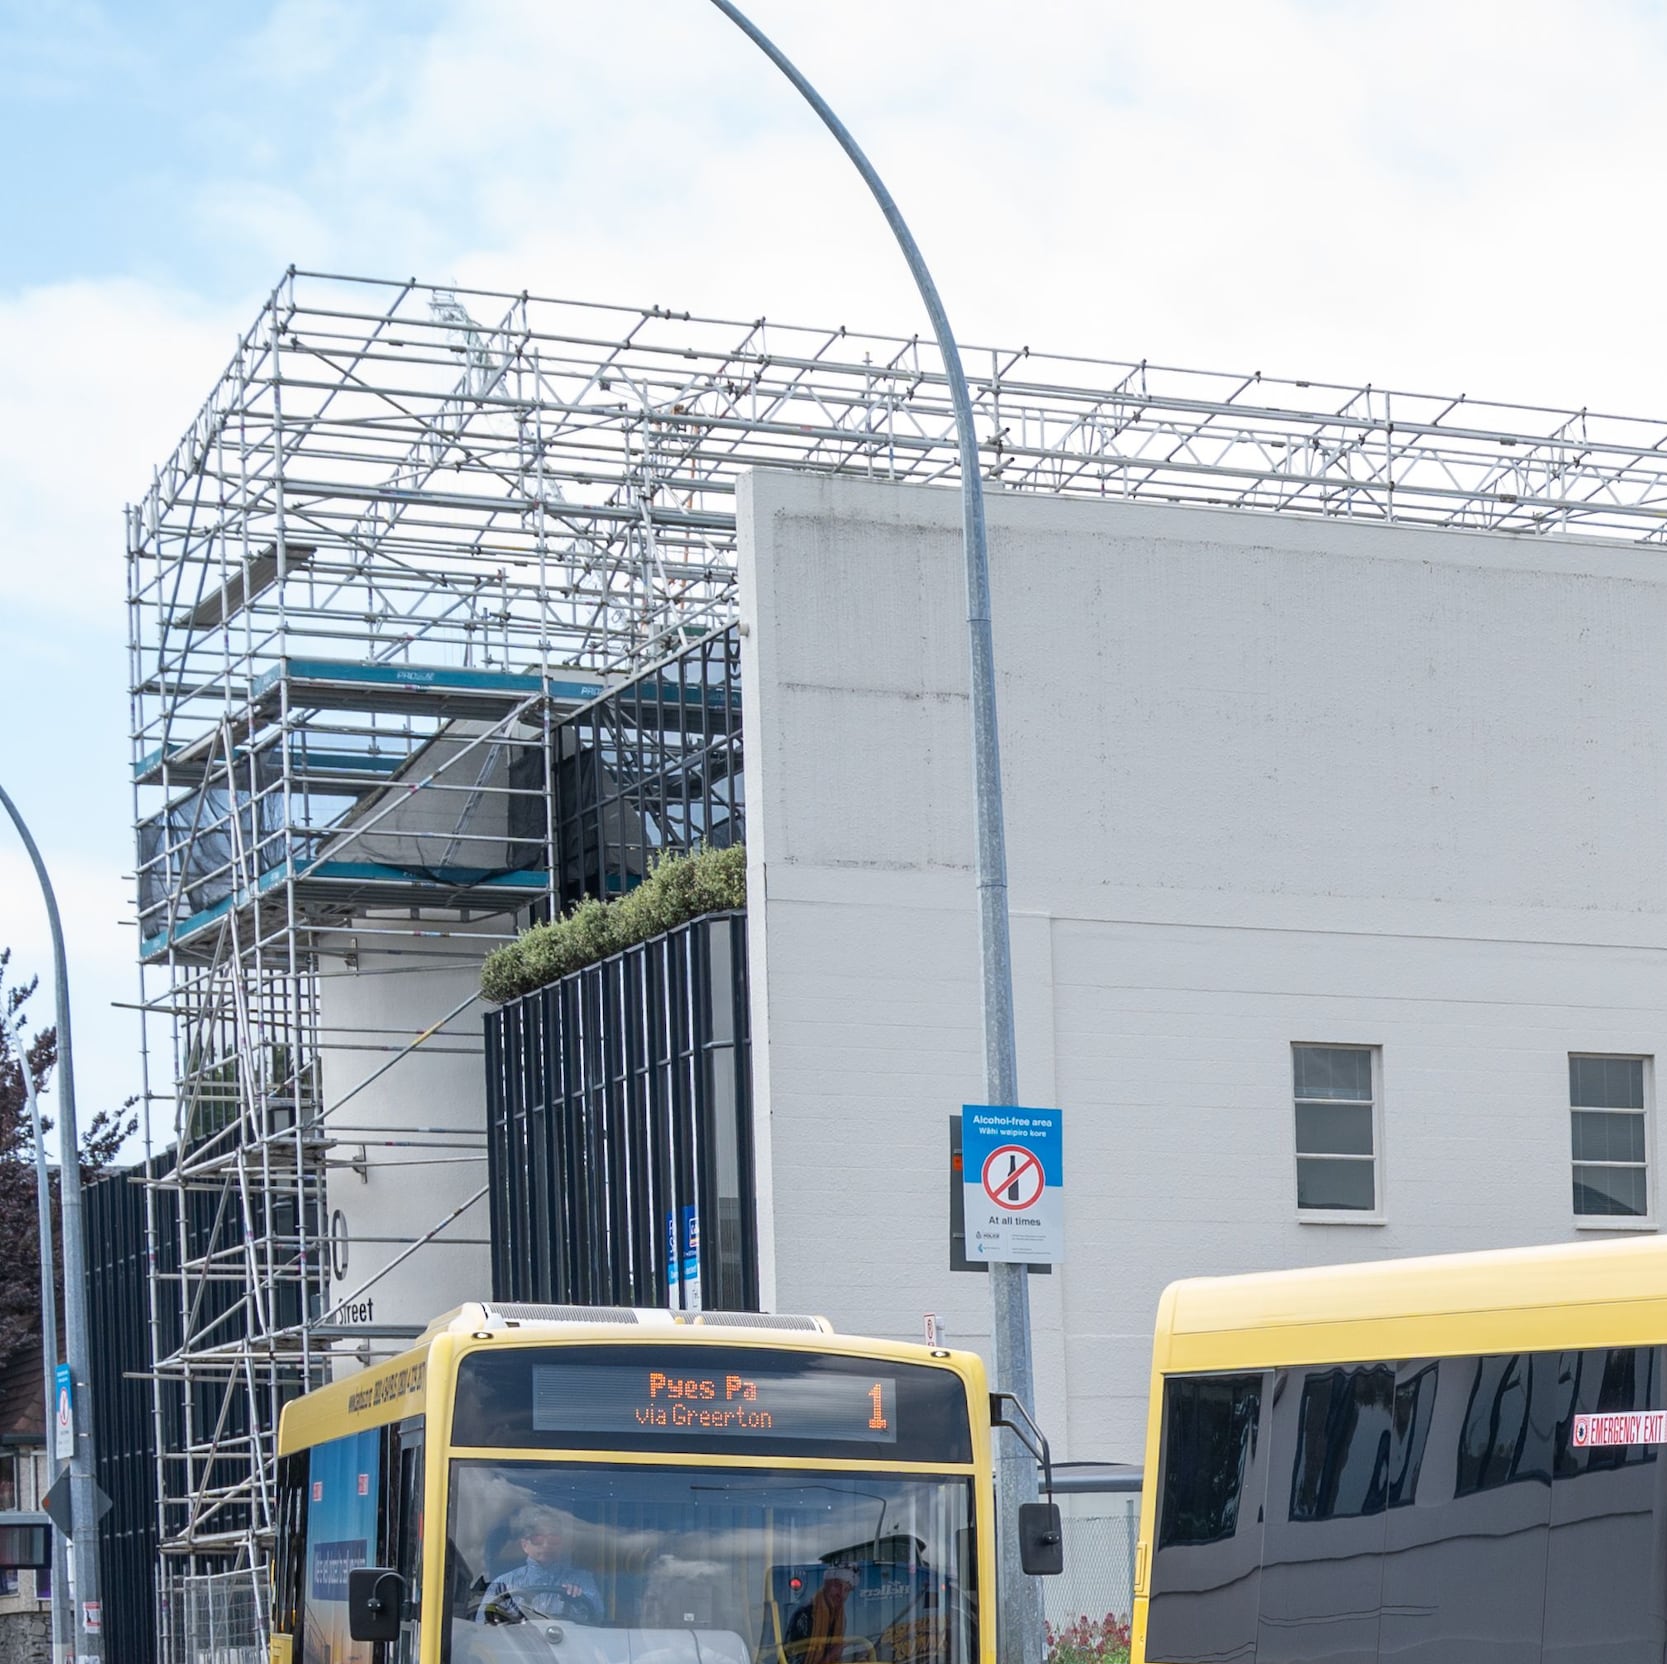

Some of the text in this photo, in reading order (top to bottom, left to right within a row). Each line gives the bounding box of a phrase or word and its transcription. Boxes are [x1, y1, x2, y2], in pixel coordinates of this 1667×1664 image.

[1032, 1119, 1052, 1127] area
[989, 1216, 1041, 1226] At all times
[649, 1372, 758, 1401] Pyes Pa
[635, 1403, 773, 1429] via Greerton
[868, 1383, 887, 1430] 1
[1590, 1415, 1664, 1445] EMERGENCY EXIT
